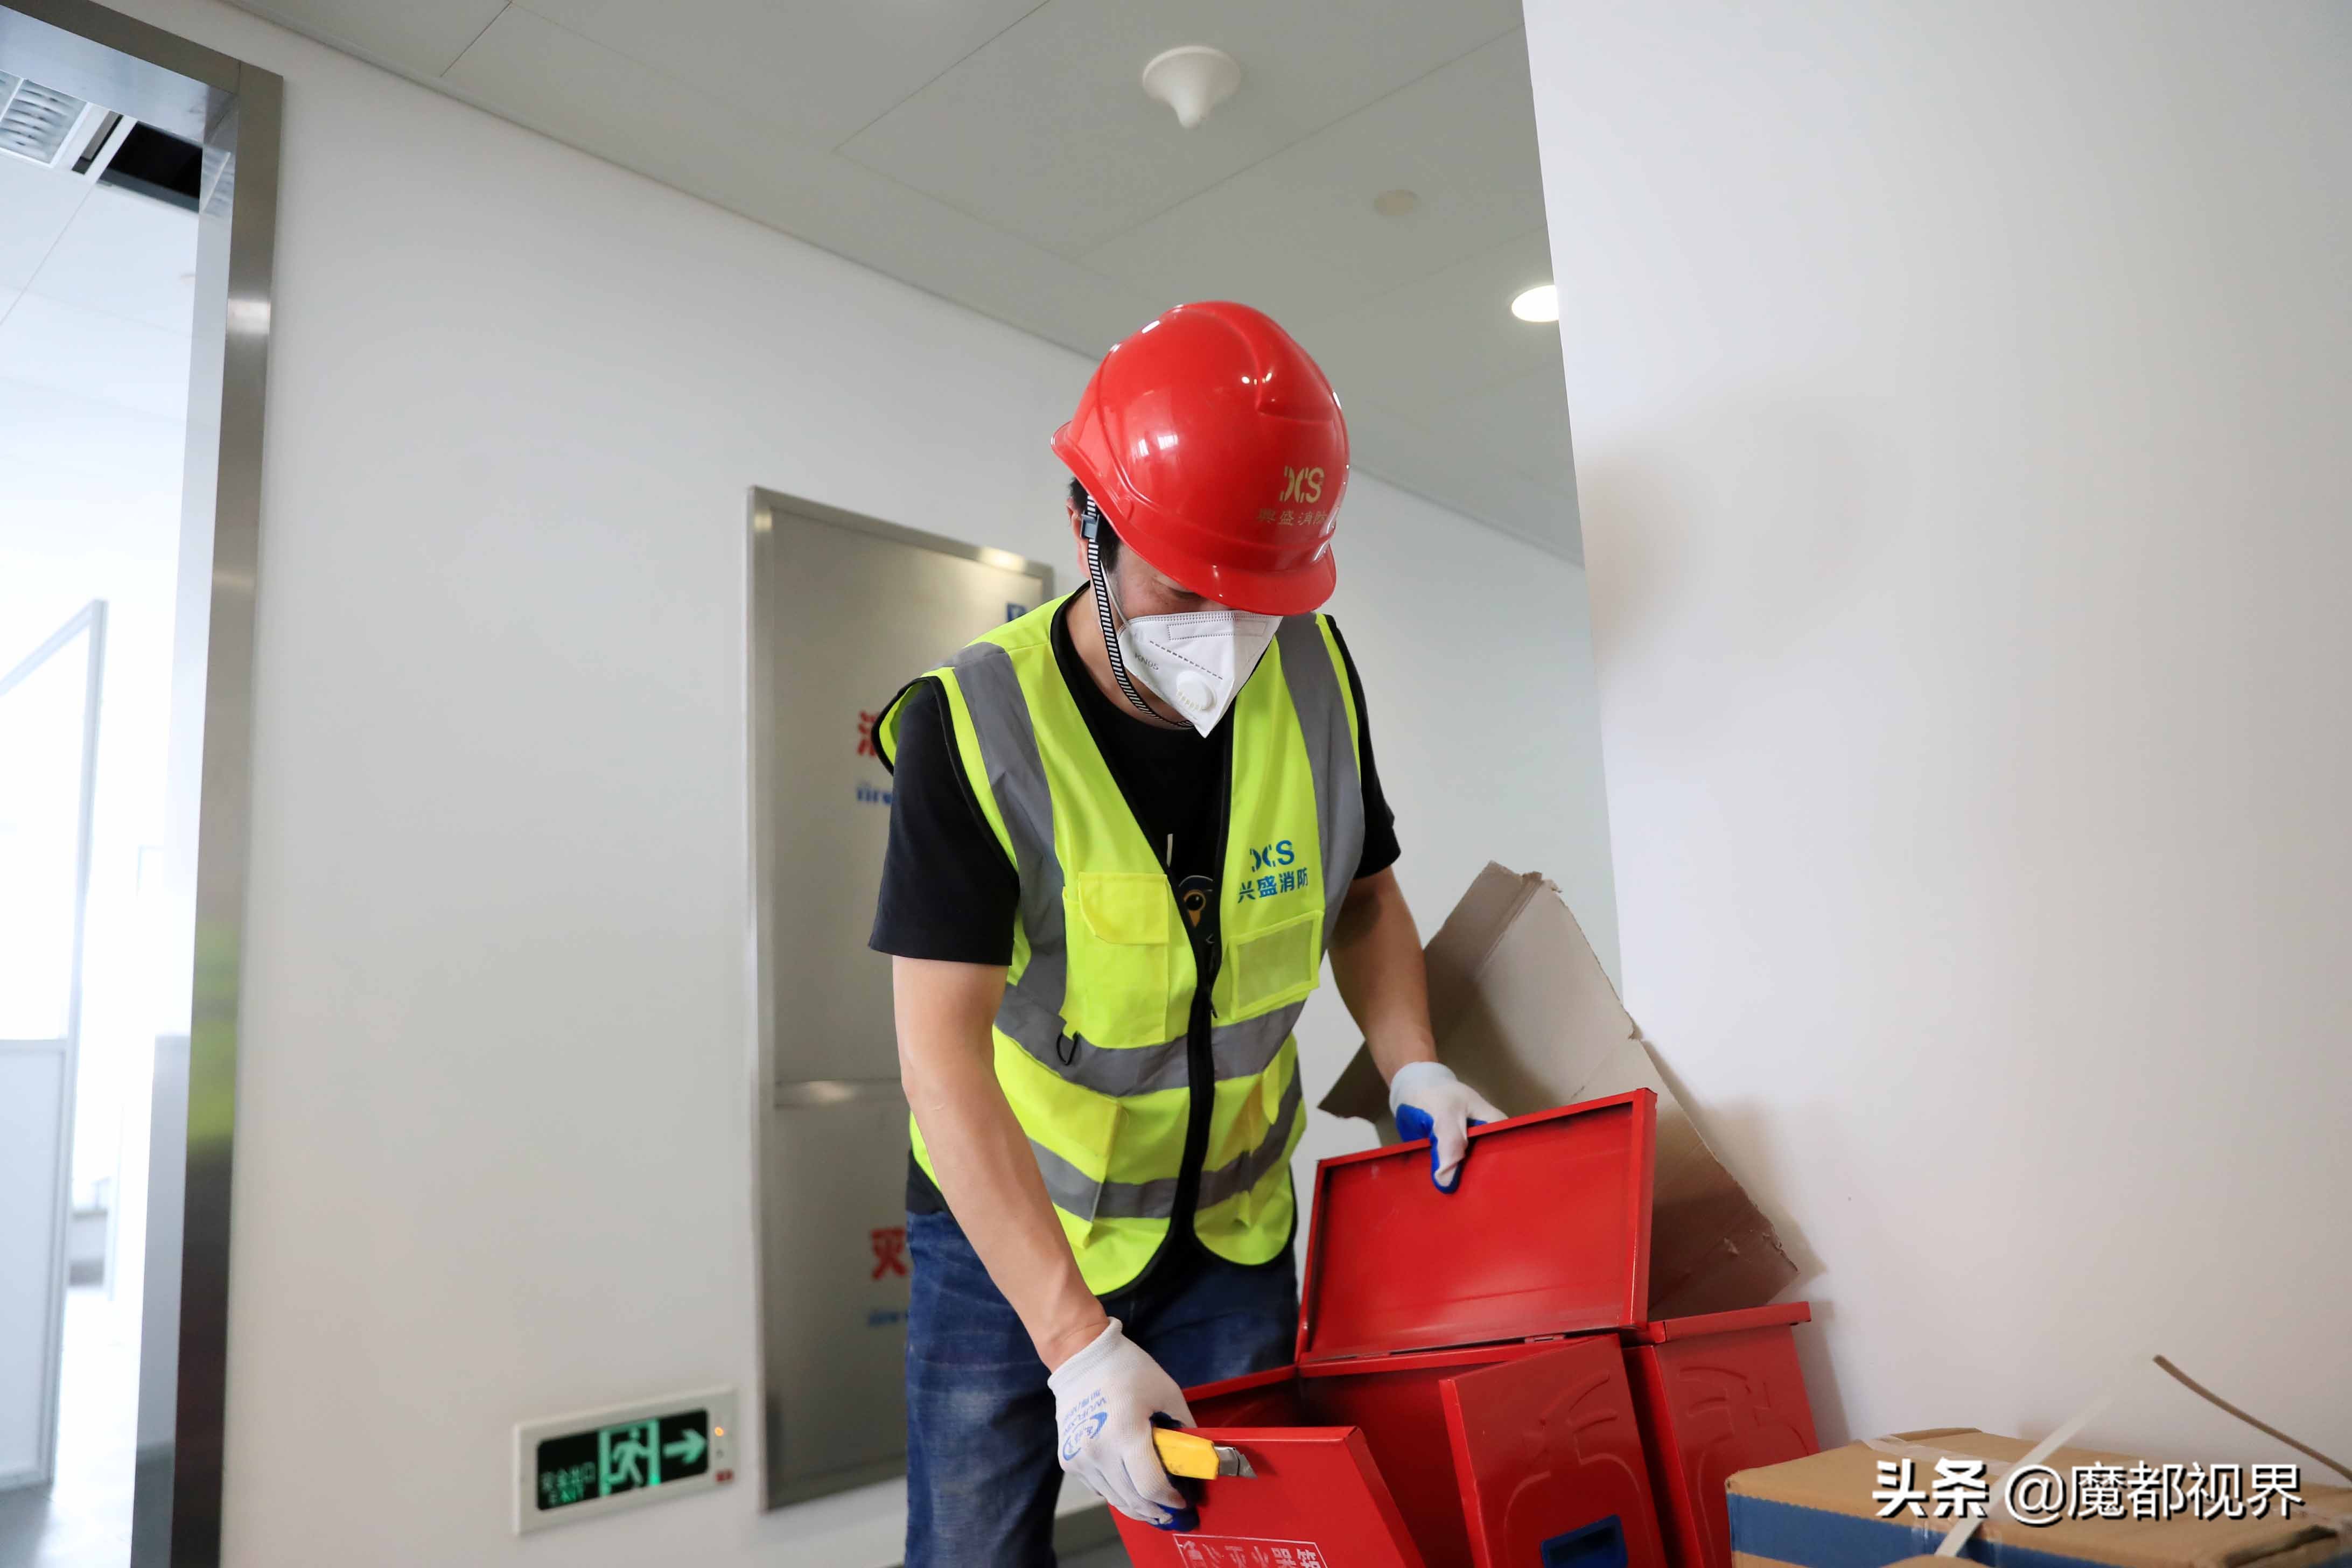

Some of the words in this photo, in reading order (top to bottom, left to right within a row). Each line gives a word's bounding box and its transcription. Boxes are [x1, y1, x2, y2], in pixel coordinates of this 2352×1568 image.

[1249, 839, 1295, 872] XS
[1238, 867, 1308, 904] 兴盛消防
